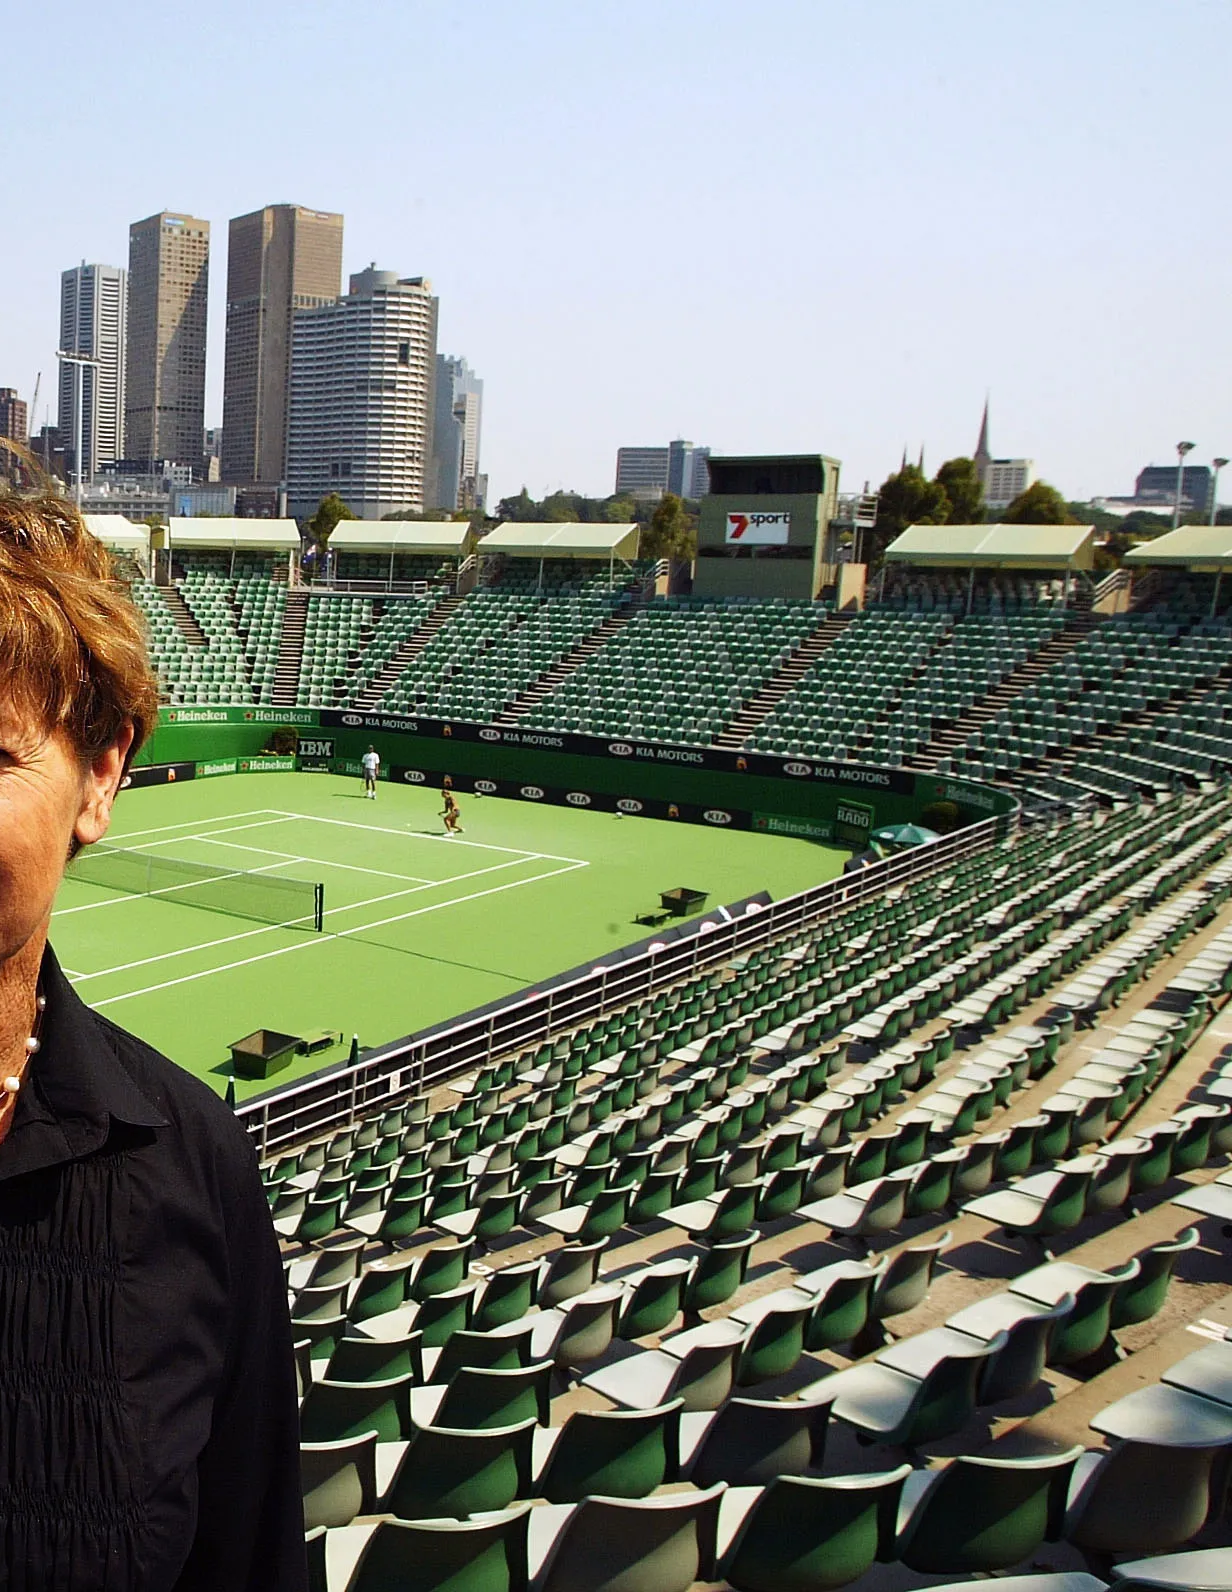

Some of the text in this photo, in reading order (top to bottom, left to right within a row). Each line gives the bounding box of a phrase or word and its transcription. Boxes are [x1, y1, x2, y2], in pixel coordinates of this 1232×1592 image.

[729, 513, 790, 539] 7 sport
[177, 710, 228, 722] Heineken
[255, 711, 312, 723] Heineken
[365, 717, 380, 727] KIA
[381, 720, 418, 731] MOTORS
[503, 732, 519, 742] KIA
[521, 734, 564, 748] MOTORS
[299, 741, 332, 756] IBM
[636, 747, 654, 757] KIA
[657, 750, 704, 763] MOTORS
[250, 760, 293, 770] Heineken
[814, 766, 836, 779] KIA
[838, 770, 891, 786] MOTORS
[523, 788, 542, 798] KIA
[569, 794, 588, 804] KIA
[619, 801, 641, 811] KIA
[706, 812, 728, 823] KIA
[837, 810, 869, 828] RADO
[768, 818, 830, 838] Heineken
